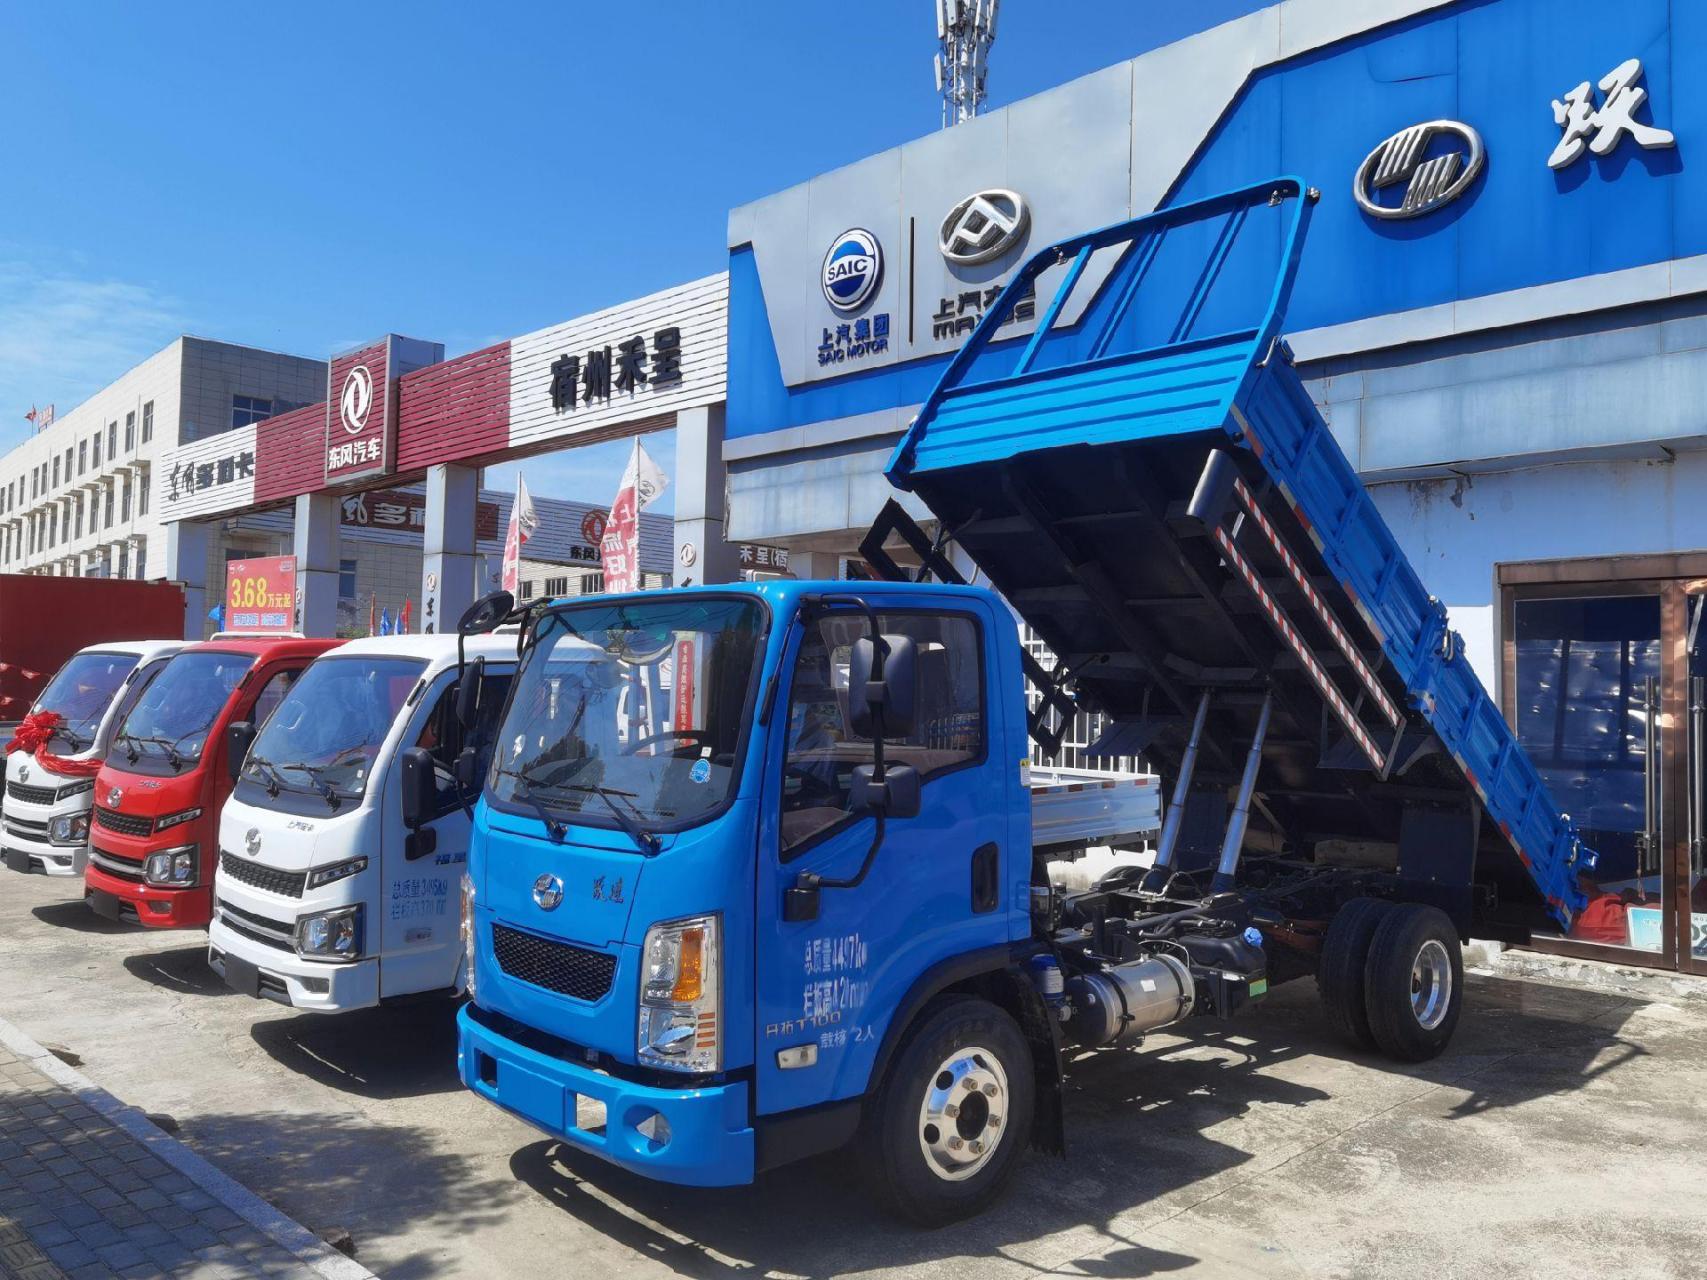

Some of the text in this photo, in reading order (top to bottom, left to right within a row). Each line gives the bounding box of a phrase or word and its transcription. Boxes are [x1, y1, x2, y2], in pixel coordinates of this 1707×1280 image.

[1548, 58, 1675, 169] 跃
[827, 257, 868, 282] SAIC
[818, 312, 890, 353] 上汽集团
[548, 326, 683, 415] 宿州禾呈
[817, 338, 889, 367] SAIC MOTOR
[328, 436, 382, 472] 东风汽车
[168, 451, 255, 502] 东风多利卡
[570, 545, 601, 562] 东风
